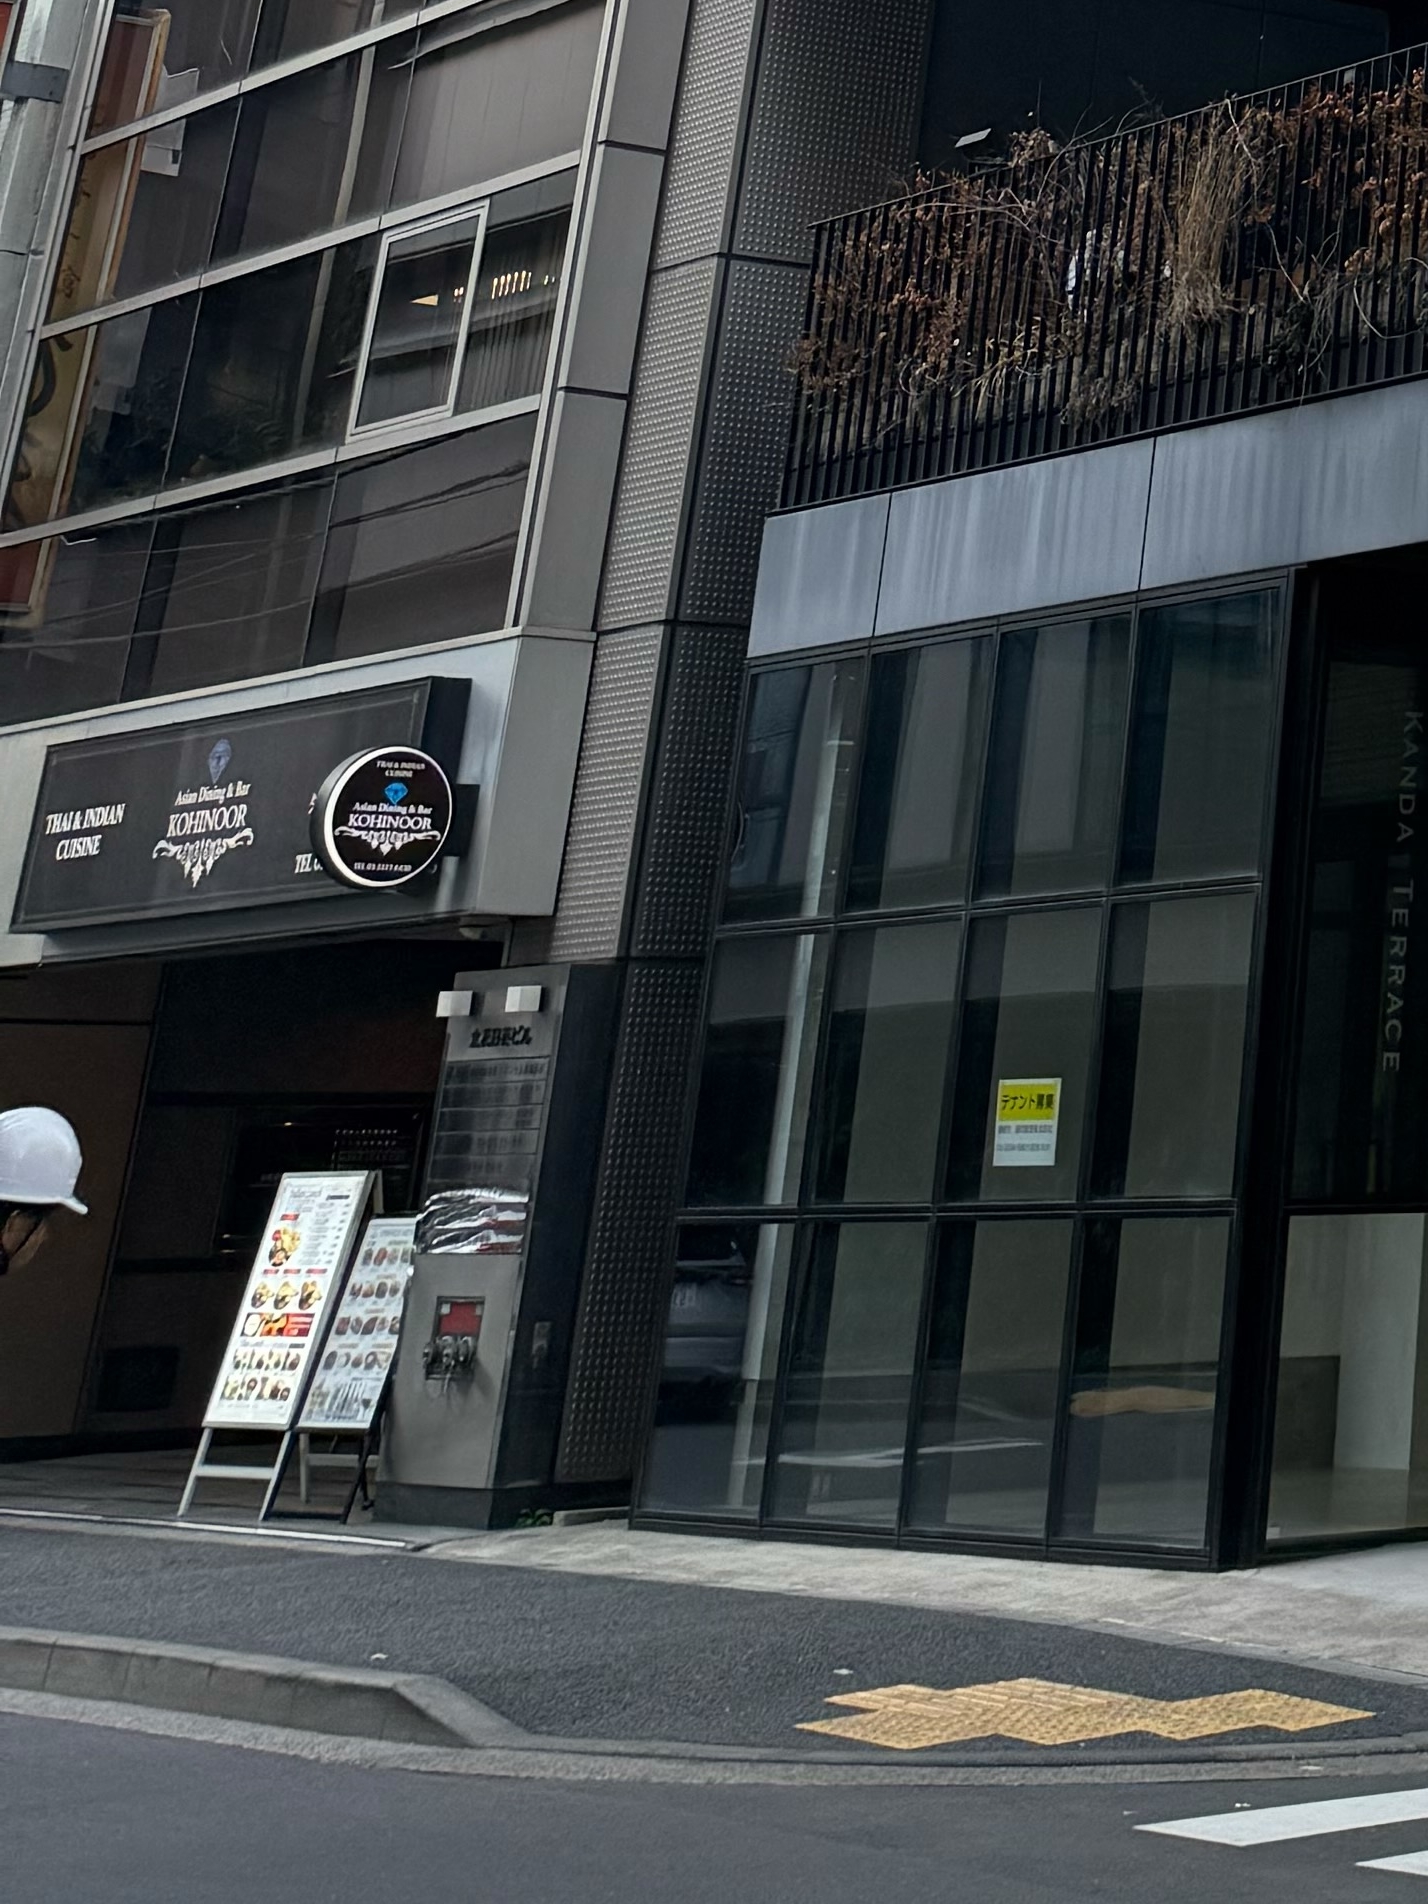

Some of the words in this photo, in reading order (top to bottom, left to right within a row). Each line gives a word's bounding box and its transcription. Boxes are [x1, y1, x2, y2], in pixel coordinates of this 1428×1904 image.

[1396, 710, 1424, 843] KANDA
[45, 812, 73, 835] THAI
[82, 803, 126, 830] INDIAN
[167, 804, 247, 838] KOHINOOR
[348, 814, 432, 829] KOHINOOR
[55, 834, 102, 861] CUISINE
[1382, 879, 1415, 1073] TERRACE
